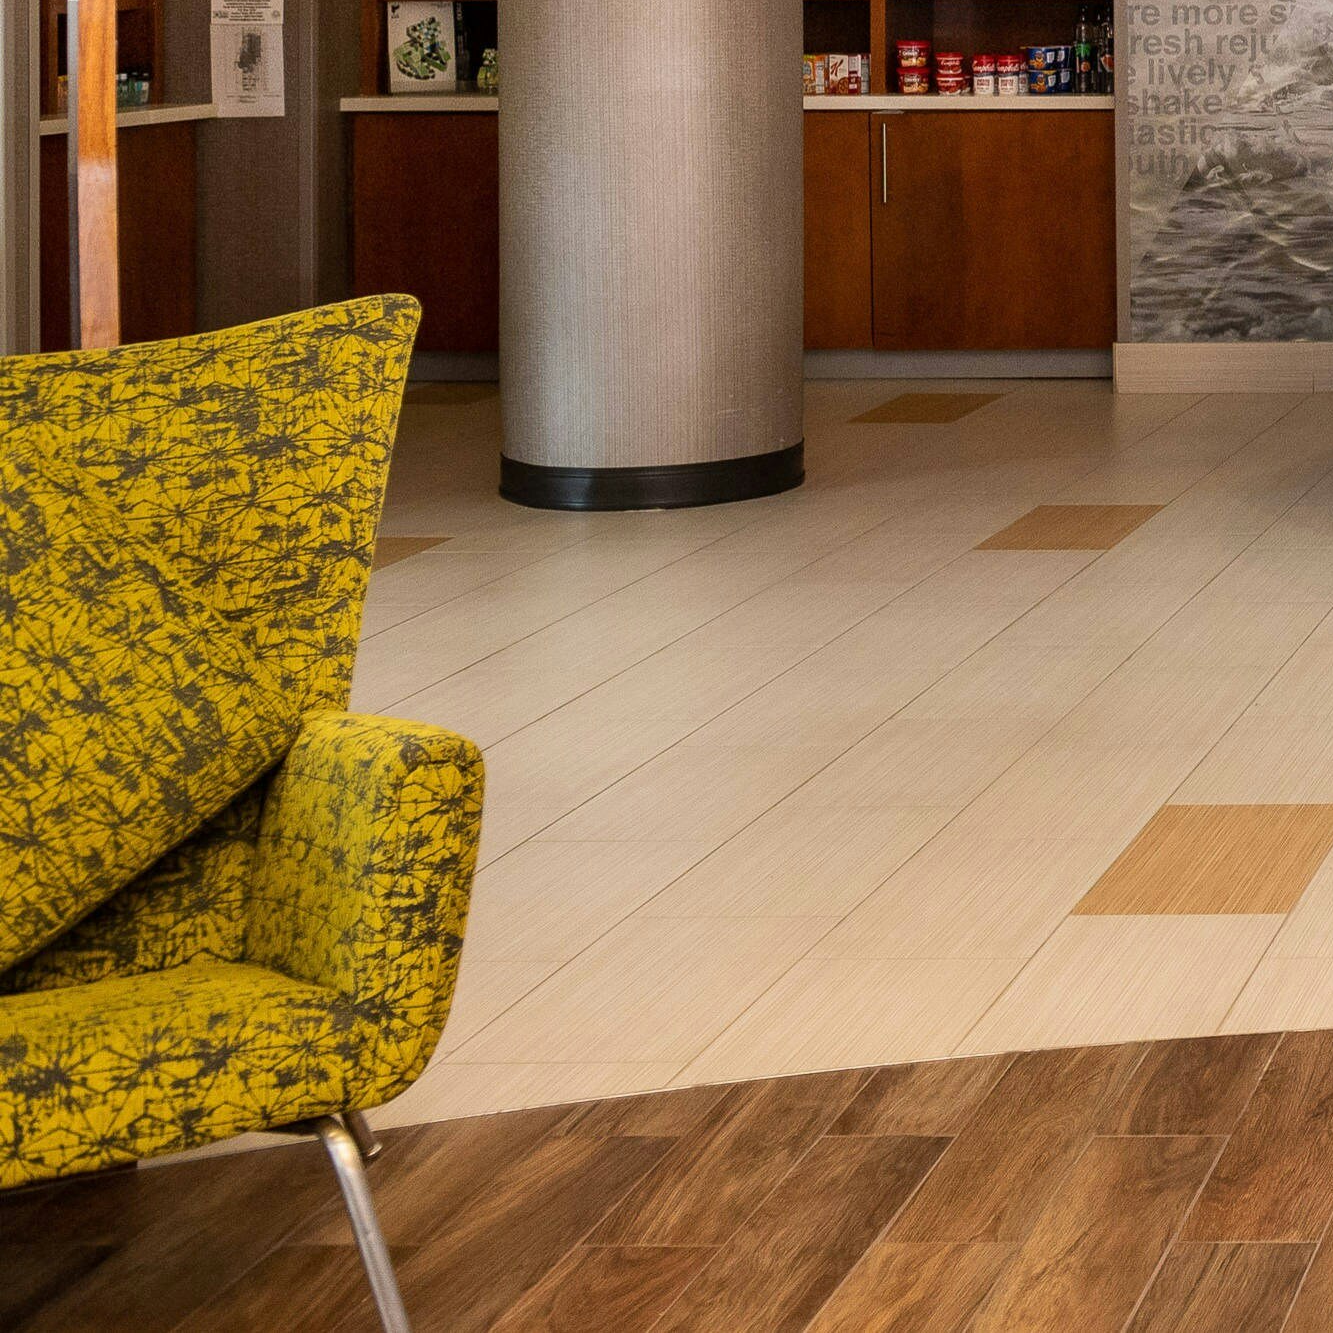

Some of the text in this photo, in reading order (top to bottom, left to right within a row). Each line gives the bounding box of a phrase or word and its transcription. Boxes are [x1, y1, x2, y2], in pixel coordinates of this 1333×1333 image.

[1171, 4, 1258, 24] more
[1148, 58, 1236, 91] lively
[1127, 88, 1222, 114] shake
